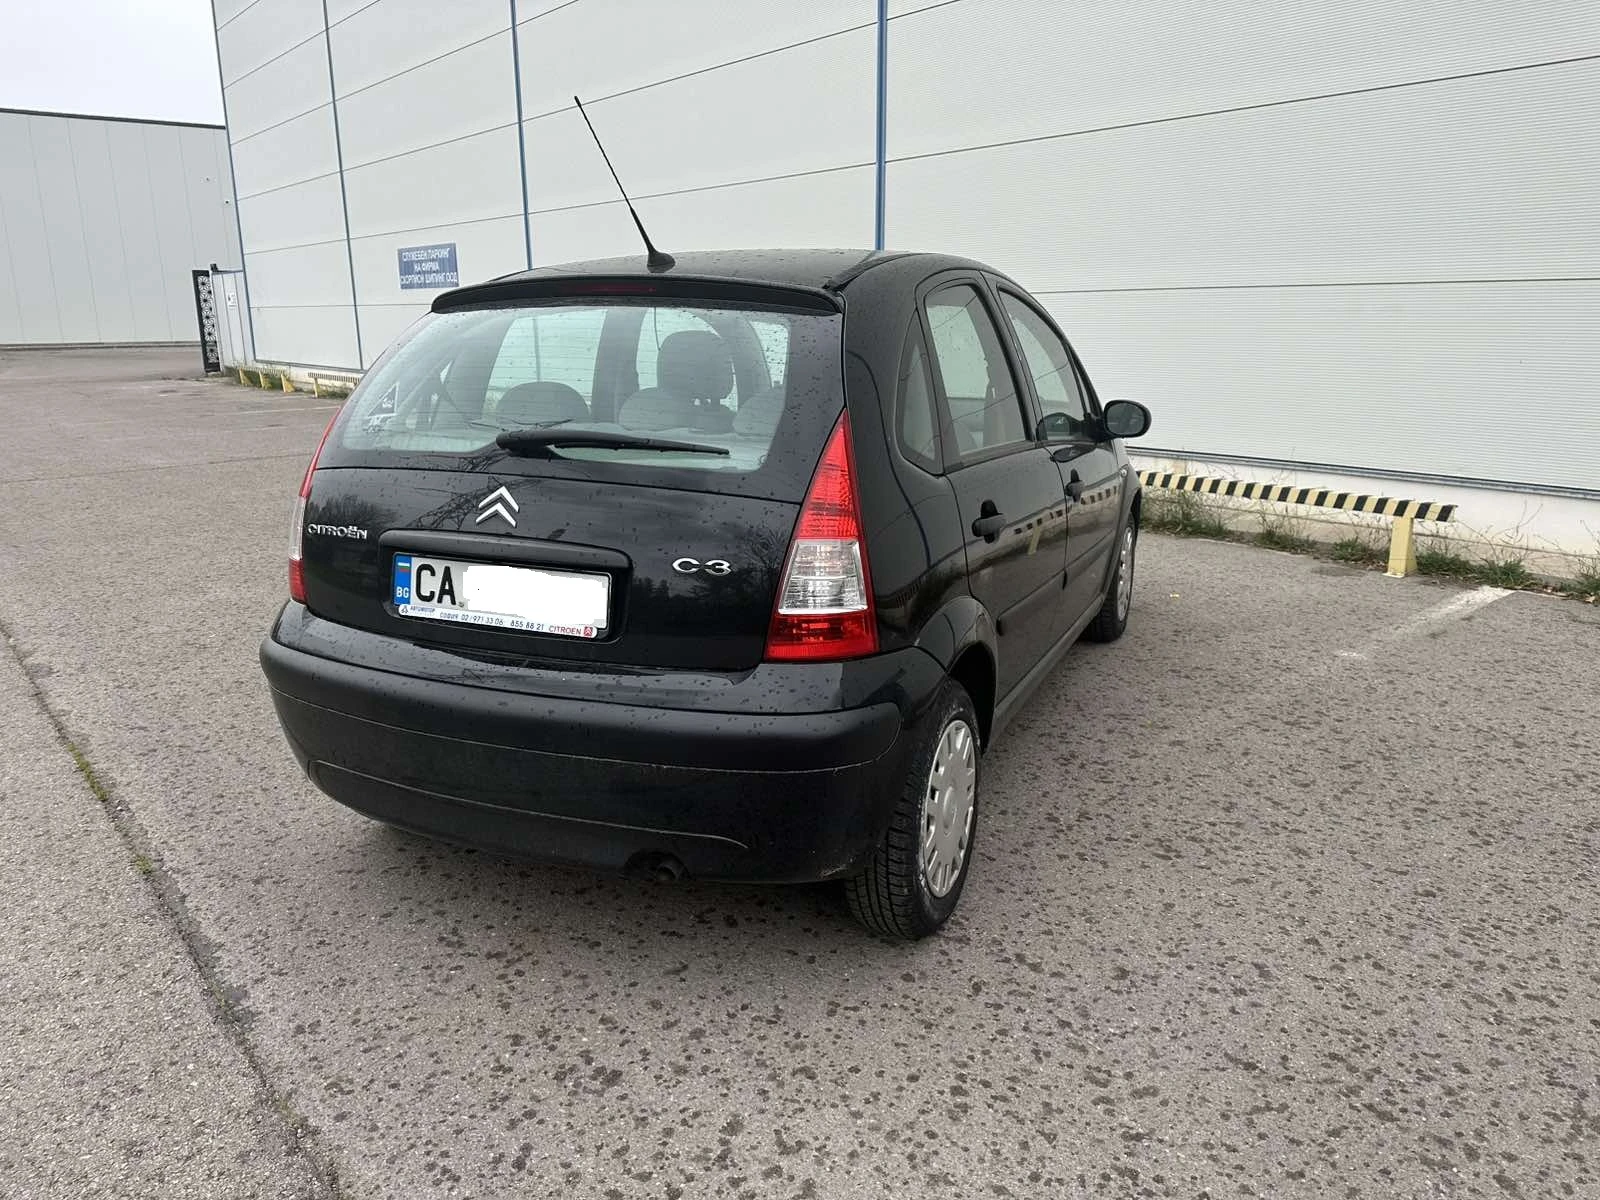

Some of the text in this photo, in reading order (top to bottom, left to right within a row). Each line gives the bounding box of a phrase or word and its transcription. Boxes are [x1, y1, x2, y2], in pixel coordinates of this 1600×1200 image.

[308, 523, 368, 539] CITROËN
[416, 563, 457, 605] CA
[396, 586, 409, 599] BG
[510, 620, 524, 628] 855
